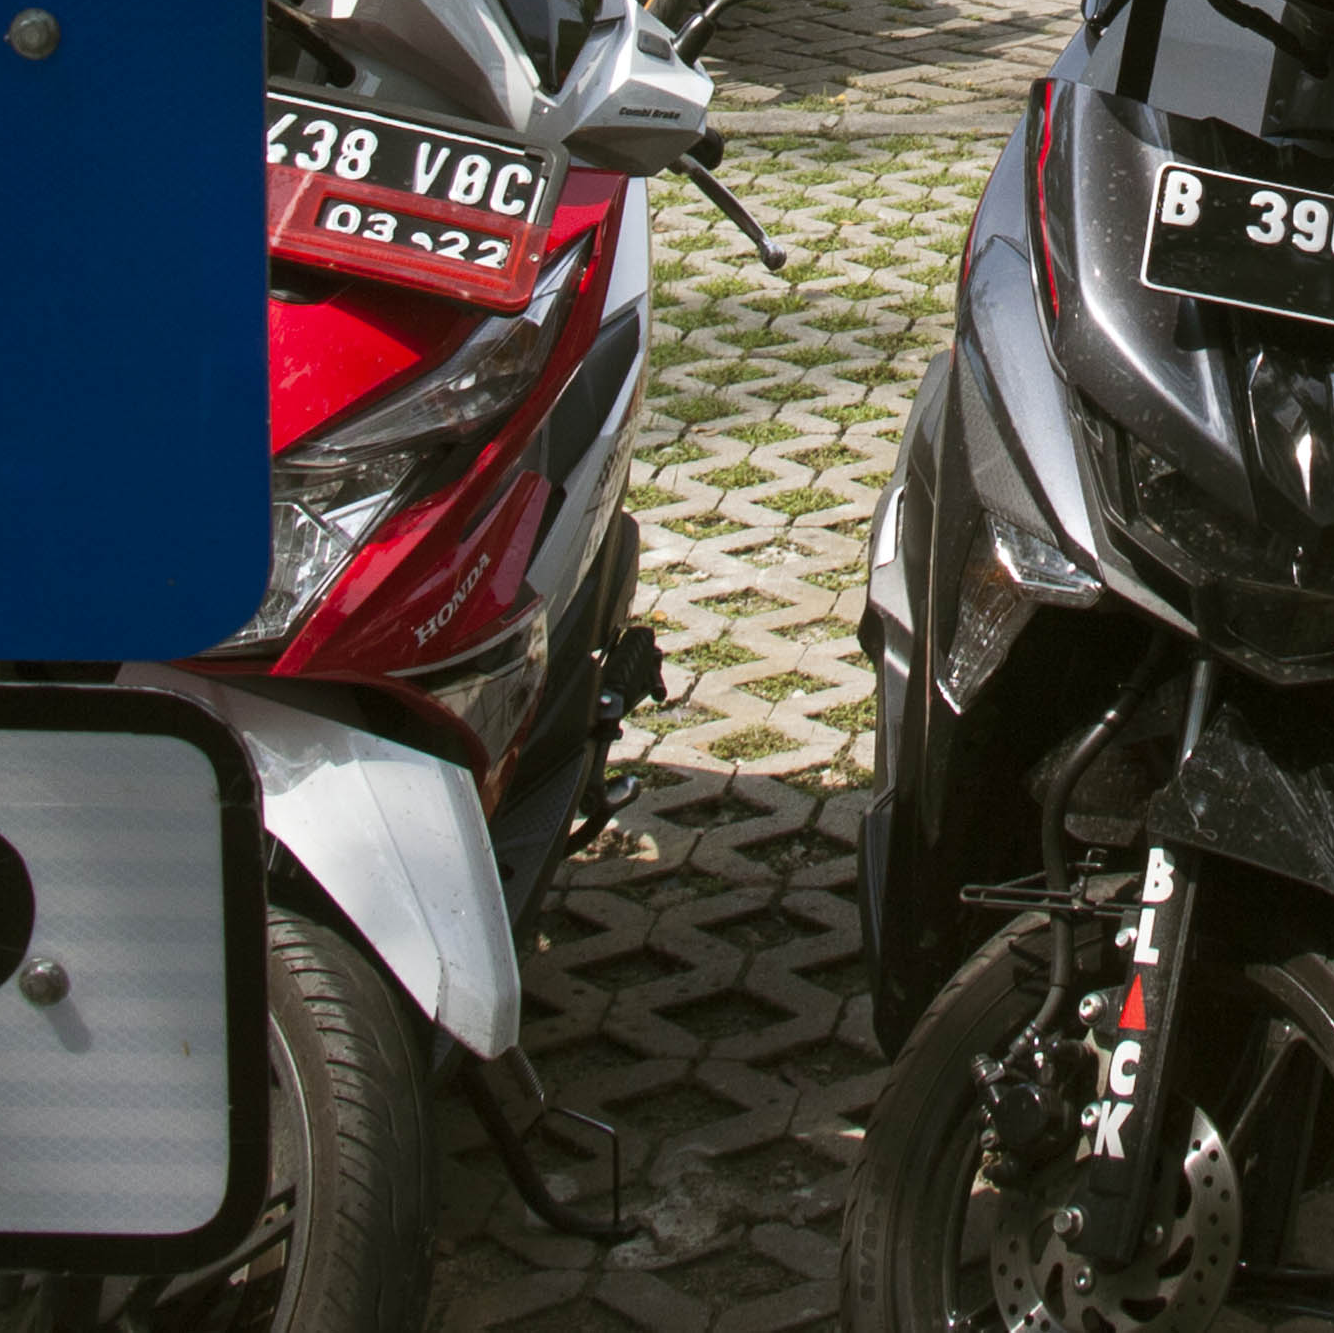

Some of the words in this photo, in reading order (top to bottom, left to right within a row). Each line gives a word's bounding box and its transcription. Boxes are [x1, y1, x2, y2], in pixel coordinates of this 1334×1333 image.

[652, 109, 681, 120] Brake
[1160, 170, 1203, 227] B
[414, 553, 490, 648] HONDA
